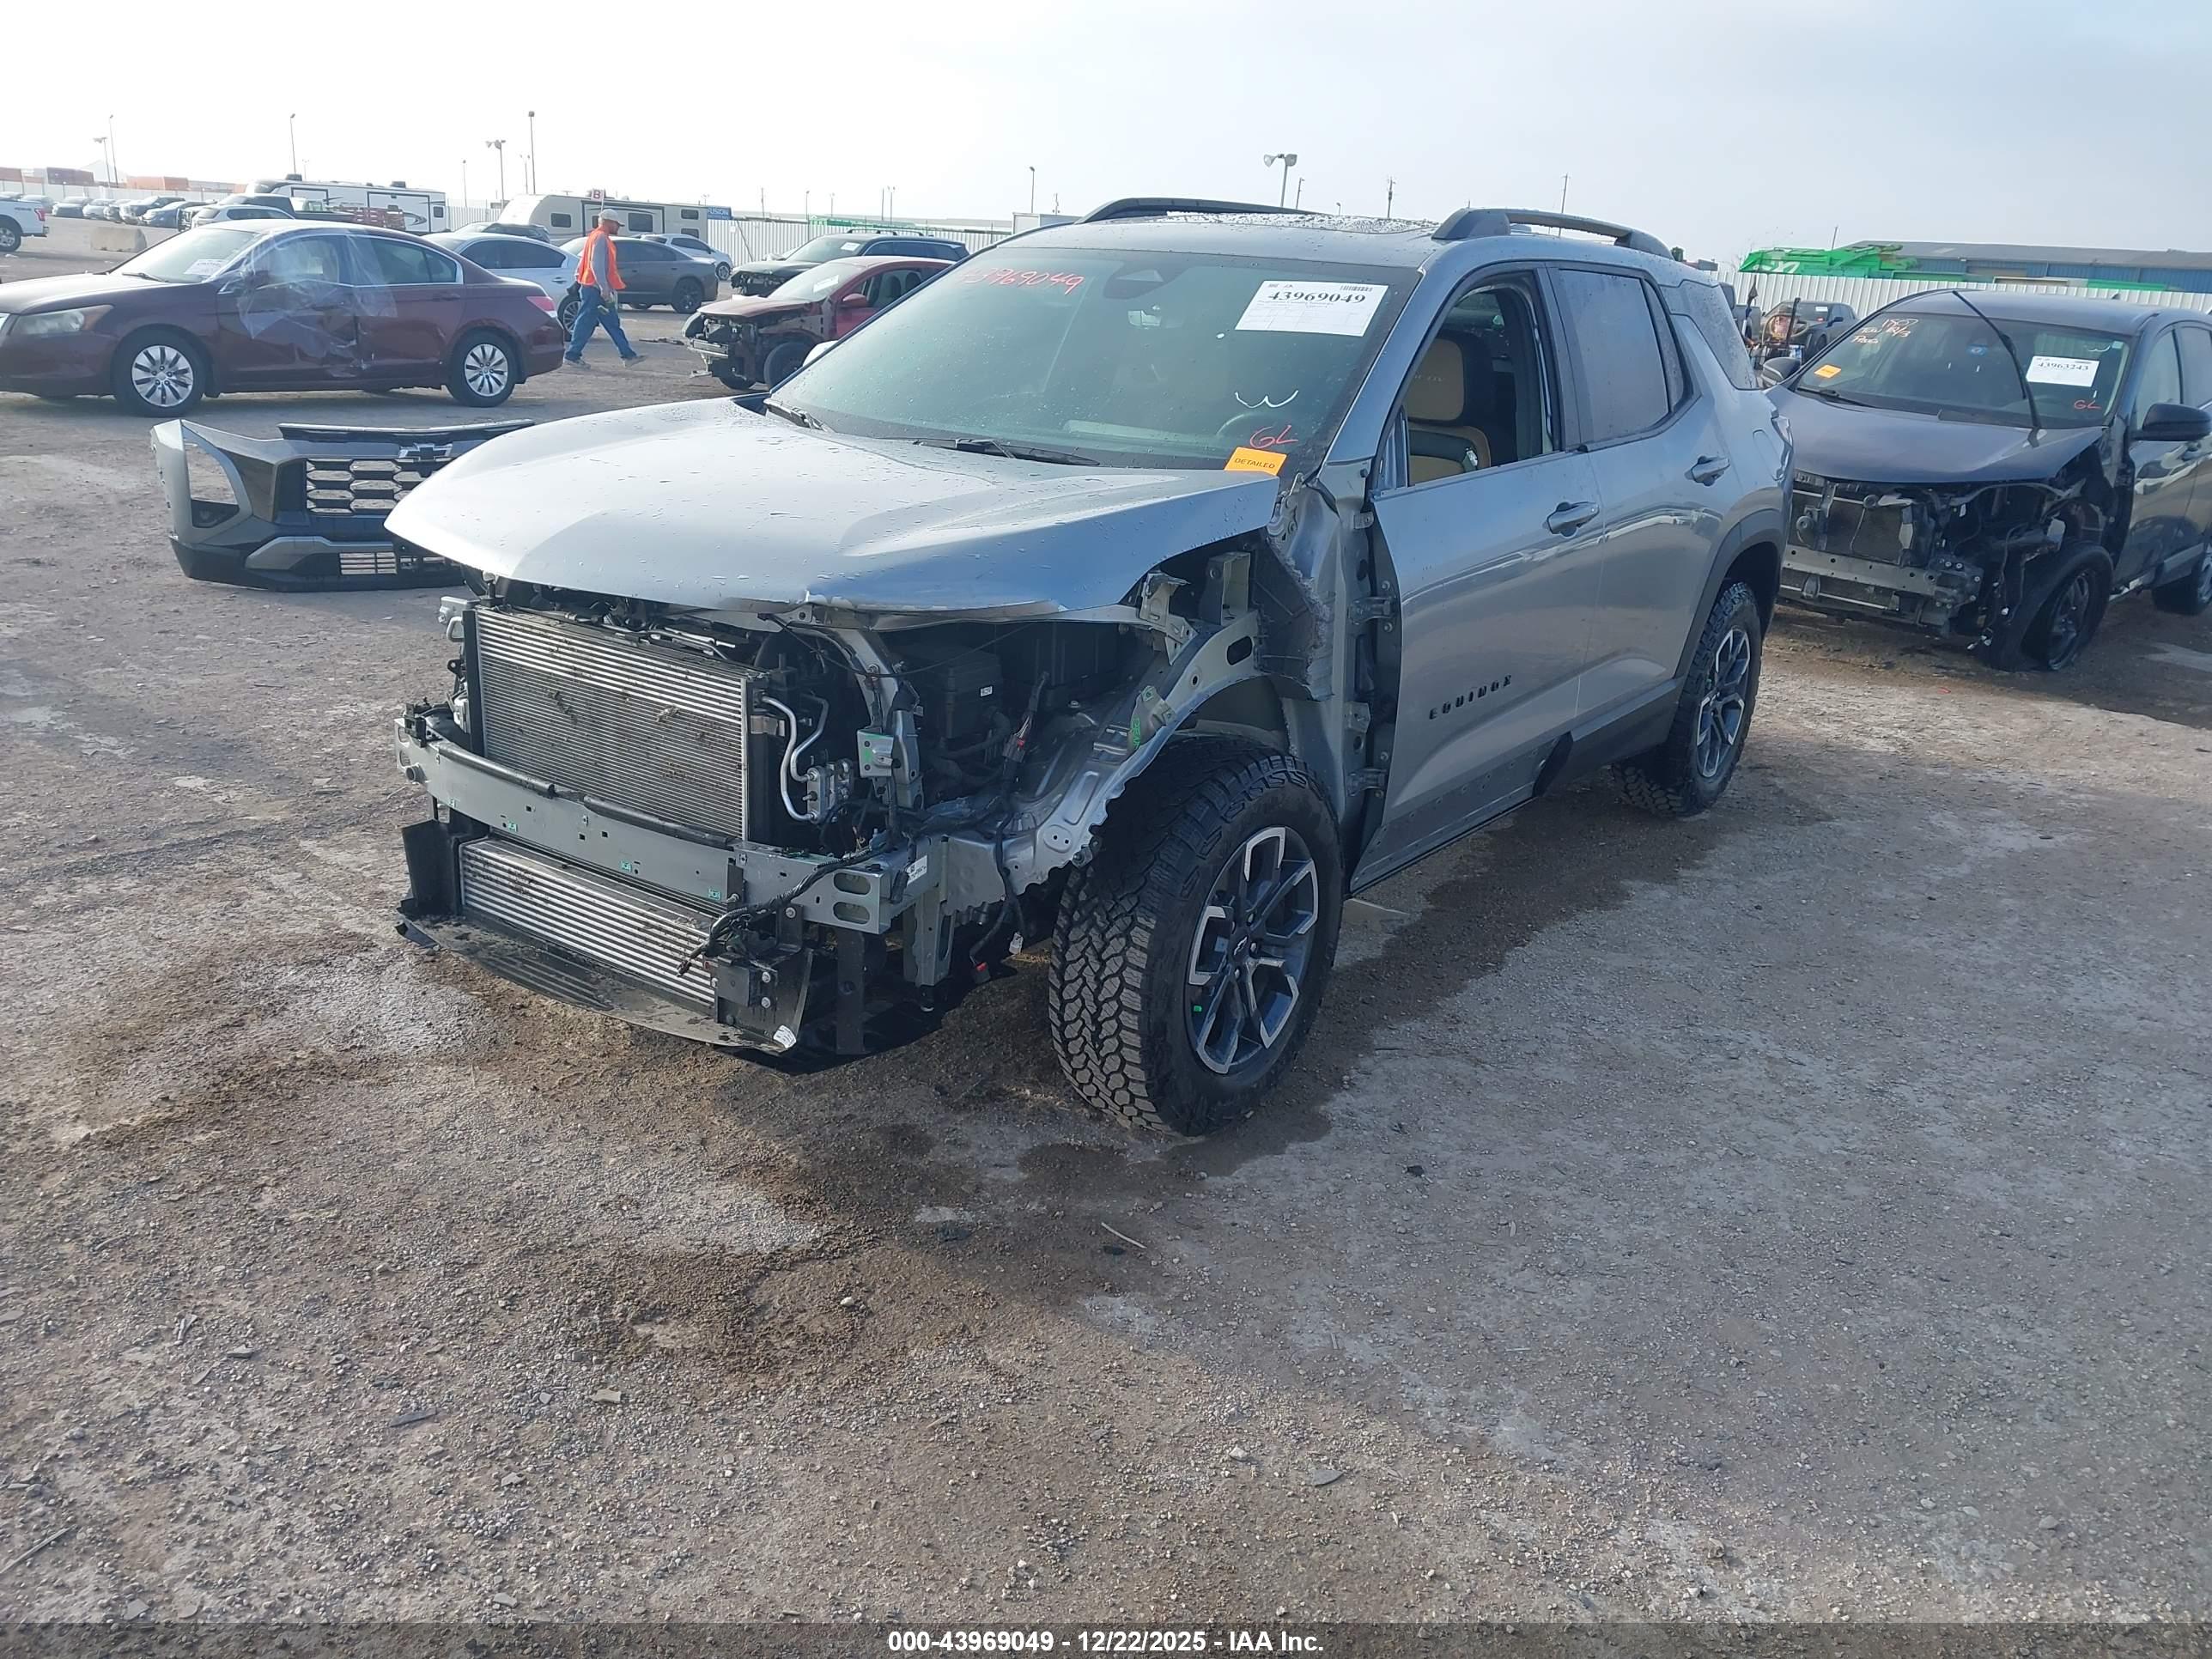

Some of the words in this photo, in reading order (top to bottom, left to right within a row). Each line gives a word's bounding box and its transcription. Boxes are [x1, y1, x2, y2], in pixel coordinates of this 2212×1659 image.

[1267, 290, 1366, 304] 43969049
[1234, 458, 1276, 469] DETAILED
[1428, 673, 1512, 720] EQUINOX
